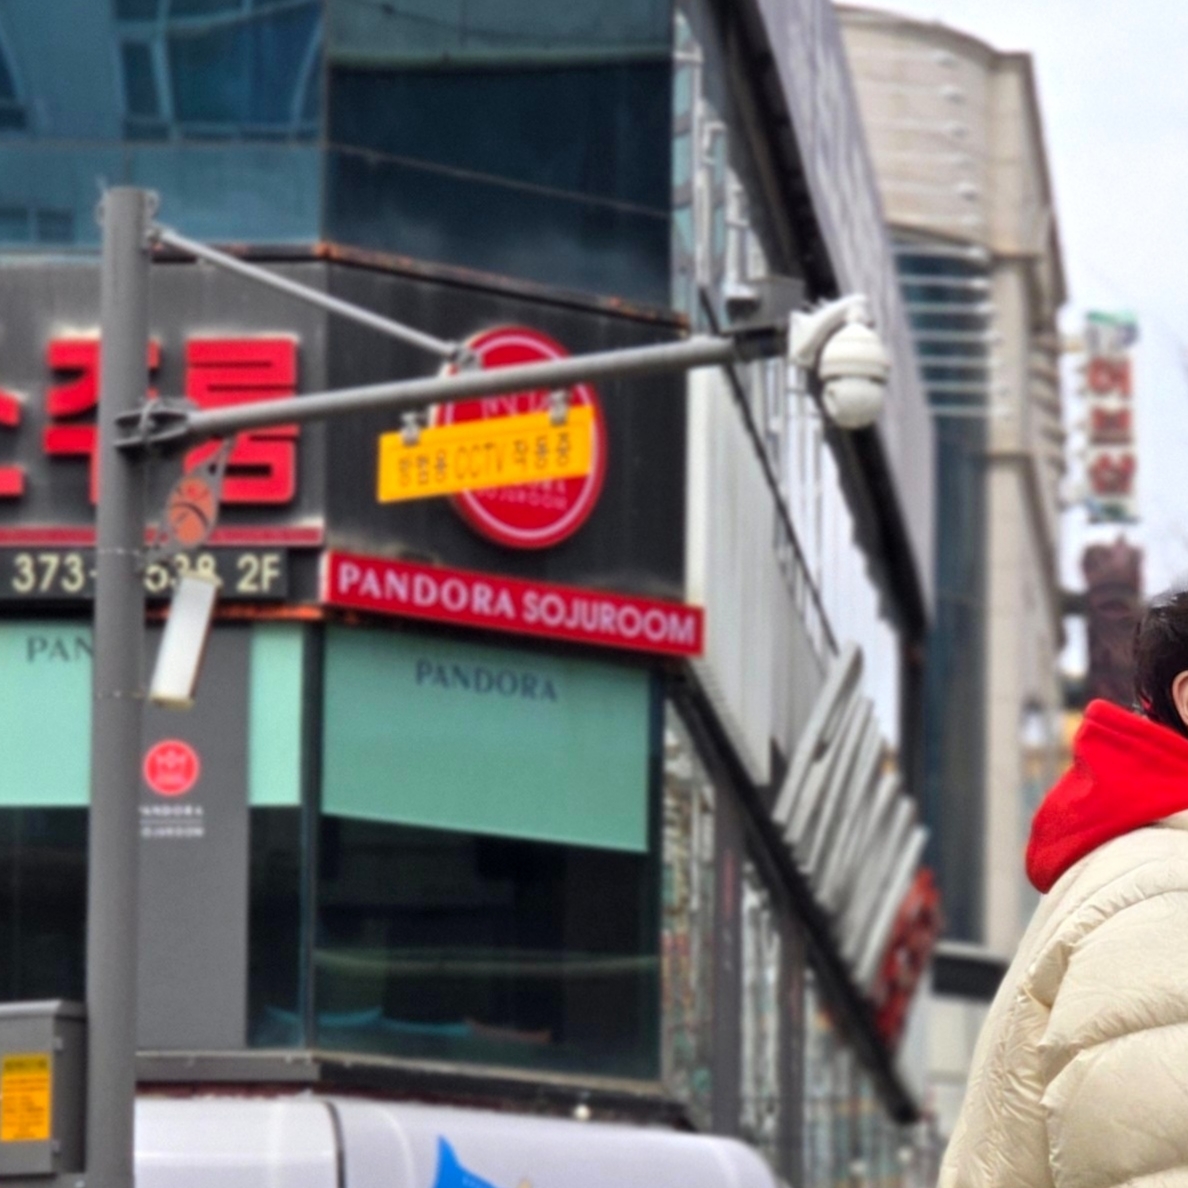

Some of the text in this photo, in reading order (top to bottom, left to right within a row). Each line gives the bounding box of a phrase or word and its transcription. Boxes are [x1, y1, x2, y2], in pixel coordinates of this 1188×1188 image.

[236, 553, 281, 592] 2F
[337, 561, 696, 645] PANDORA SOJUROOM
[415, 657, 559, 703] PANDORA
